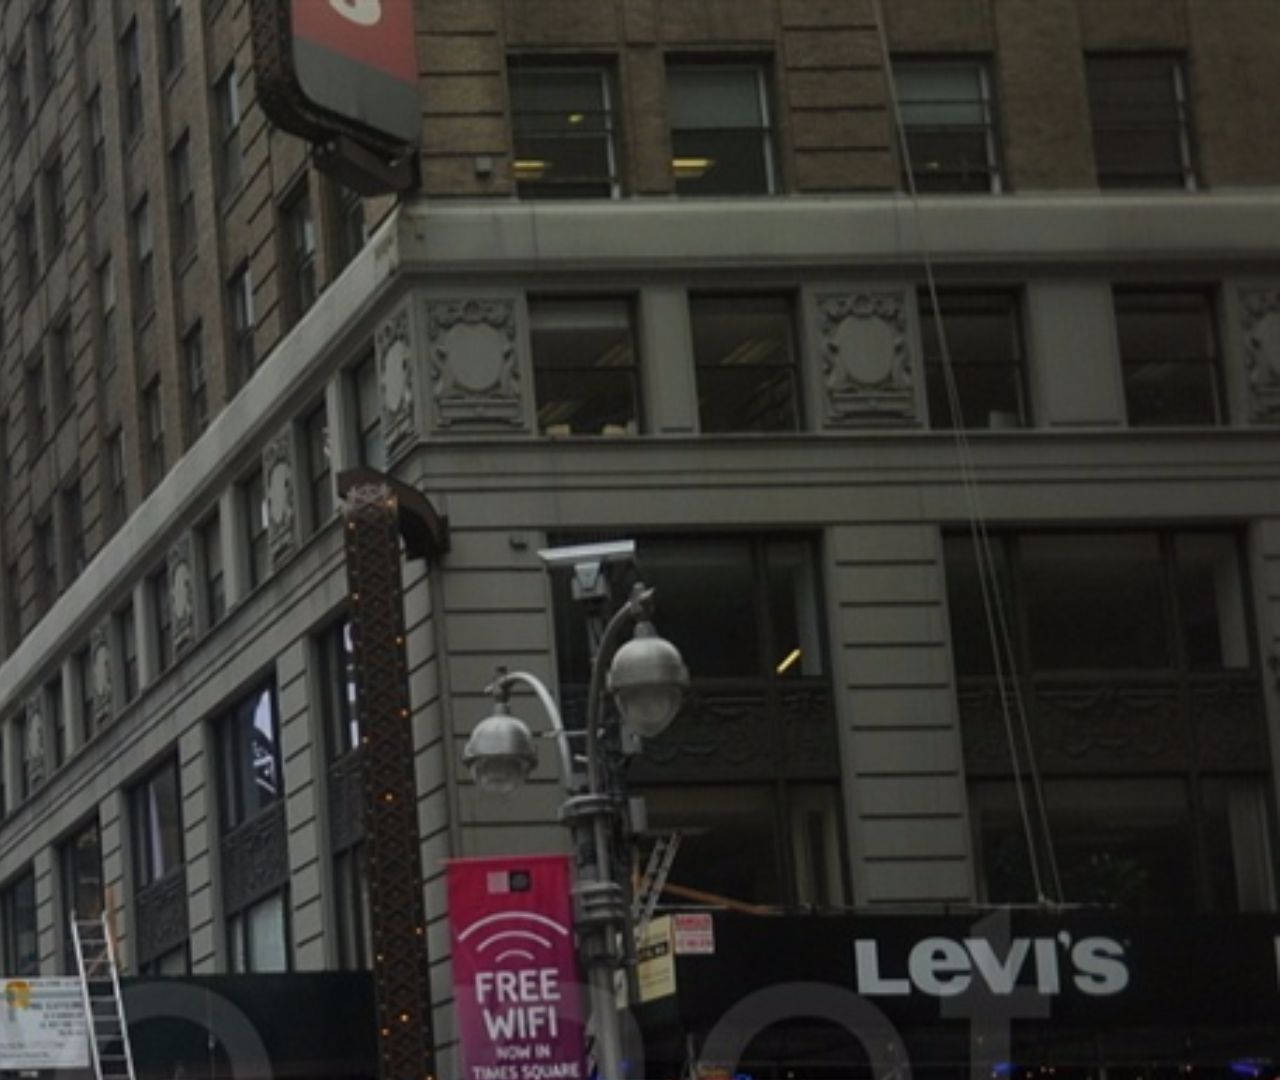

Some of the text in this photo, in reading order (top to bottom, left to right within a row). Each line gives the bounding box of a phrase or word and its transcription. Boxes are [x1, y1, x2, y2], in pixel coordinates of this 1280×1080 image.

[474, 969, 561, 1004] FREE
[483, 1006, 559, 1041] WIFI
[496, 1044, 552, 1060] NOW IN
[473, 1065, 518, 1080] TIMES
